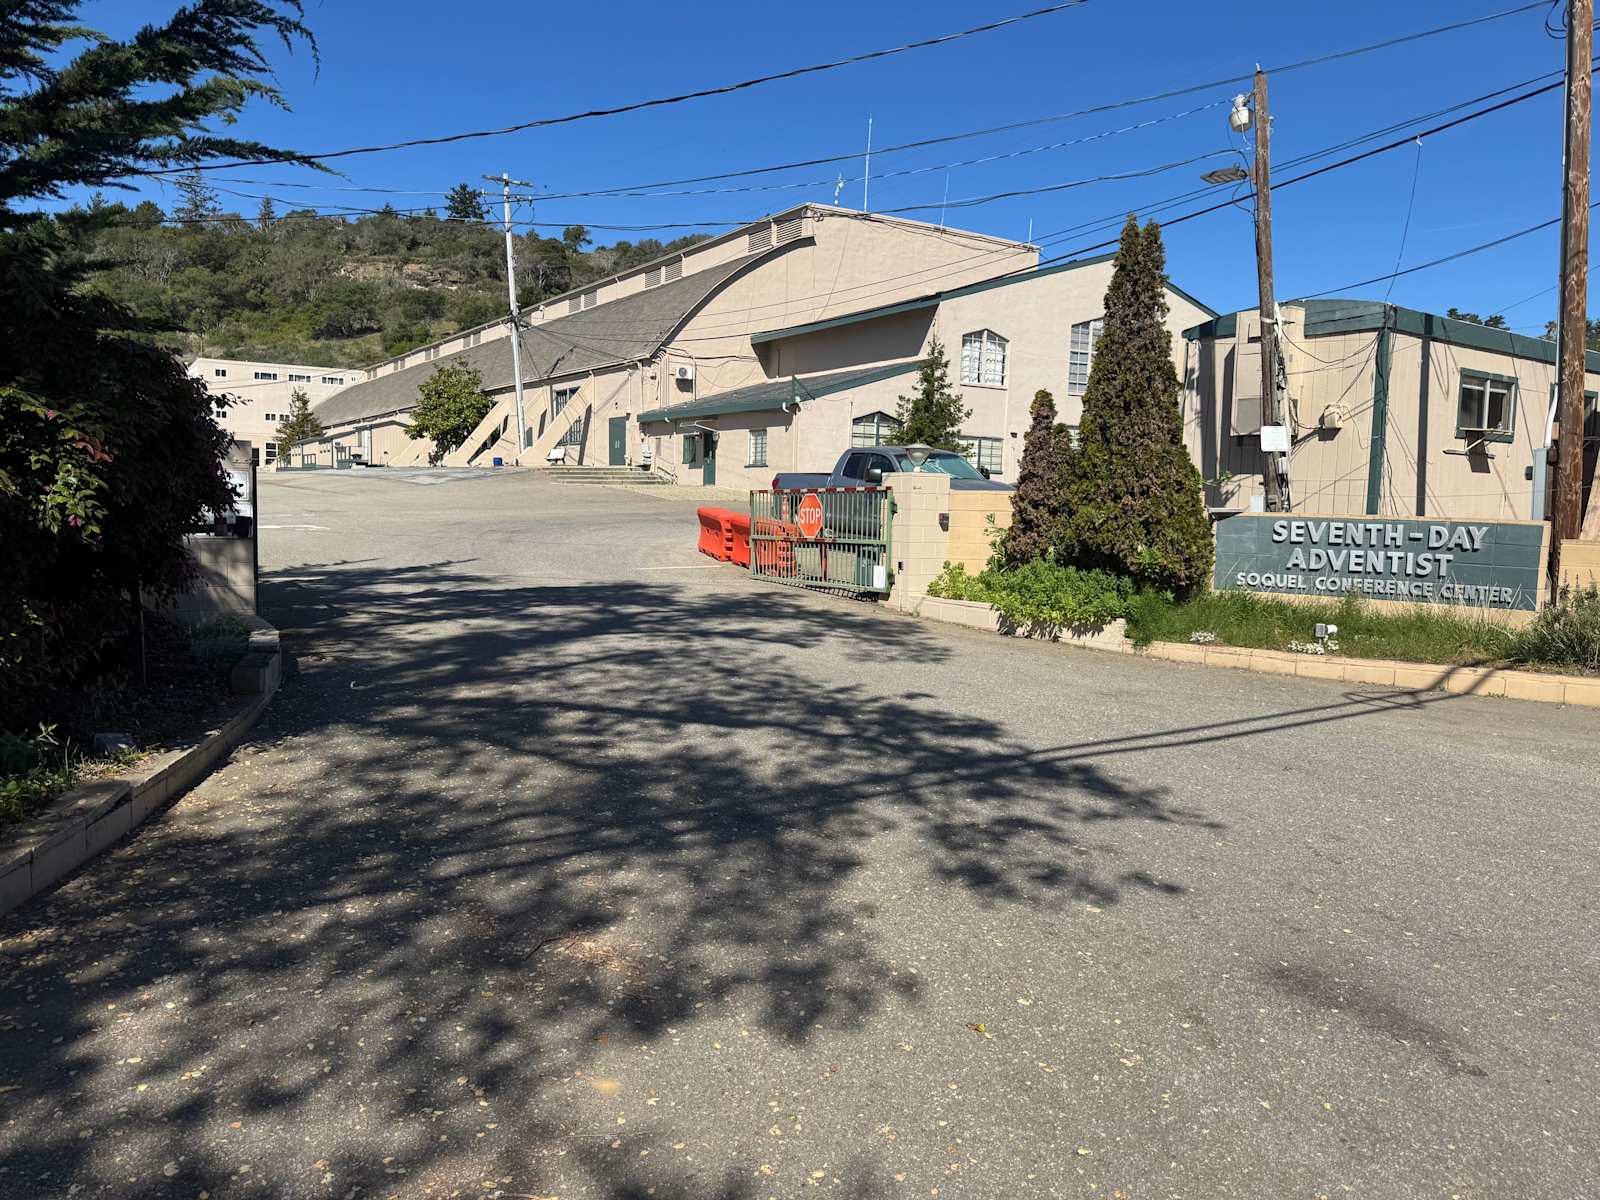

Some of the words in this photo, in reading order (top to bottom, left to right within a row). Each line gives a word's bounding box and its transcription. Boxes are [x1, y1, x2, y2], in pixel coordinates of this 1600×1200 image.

[801, 508, 820, 523] STOP
[1287, 548, 1454, 576] ADVENTIST
[1237, 572, 1306, 589] SOQUEL
[1315, 576, 1433, 598] CONFERENCE
[1441, 583, 1512, 603] CENTER
